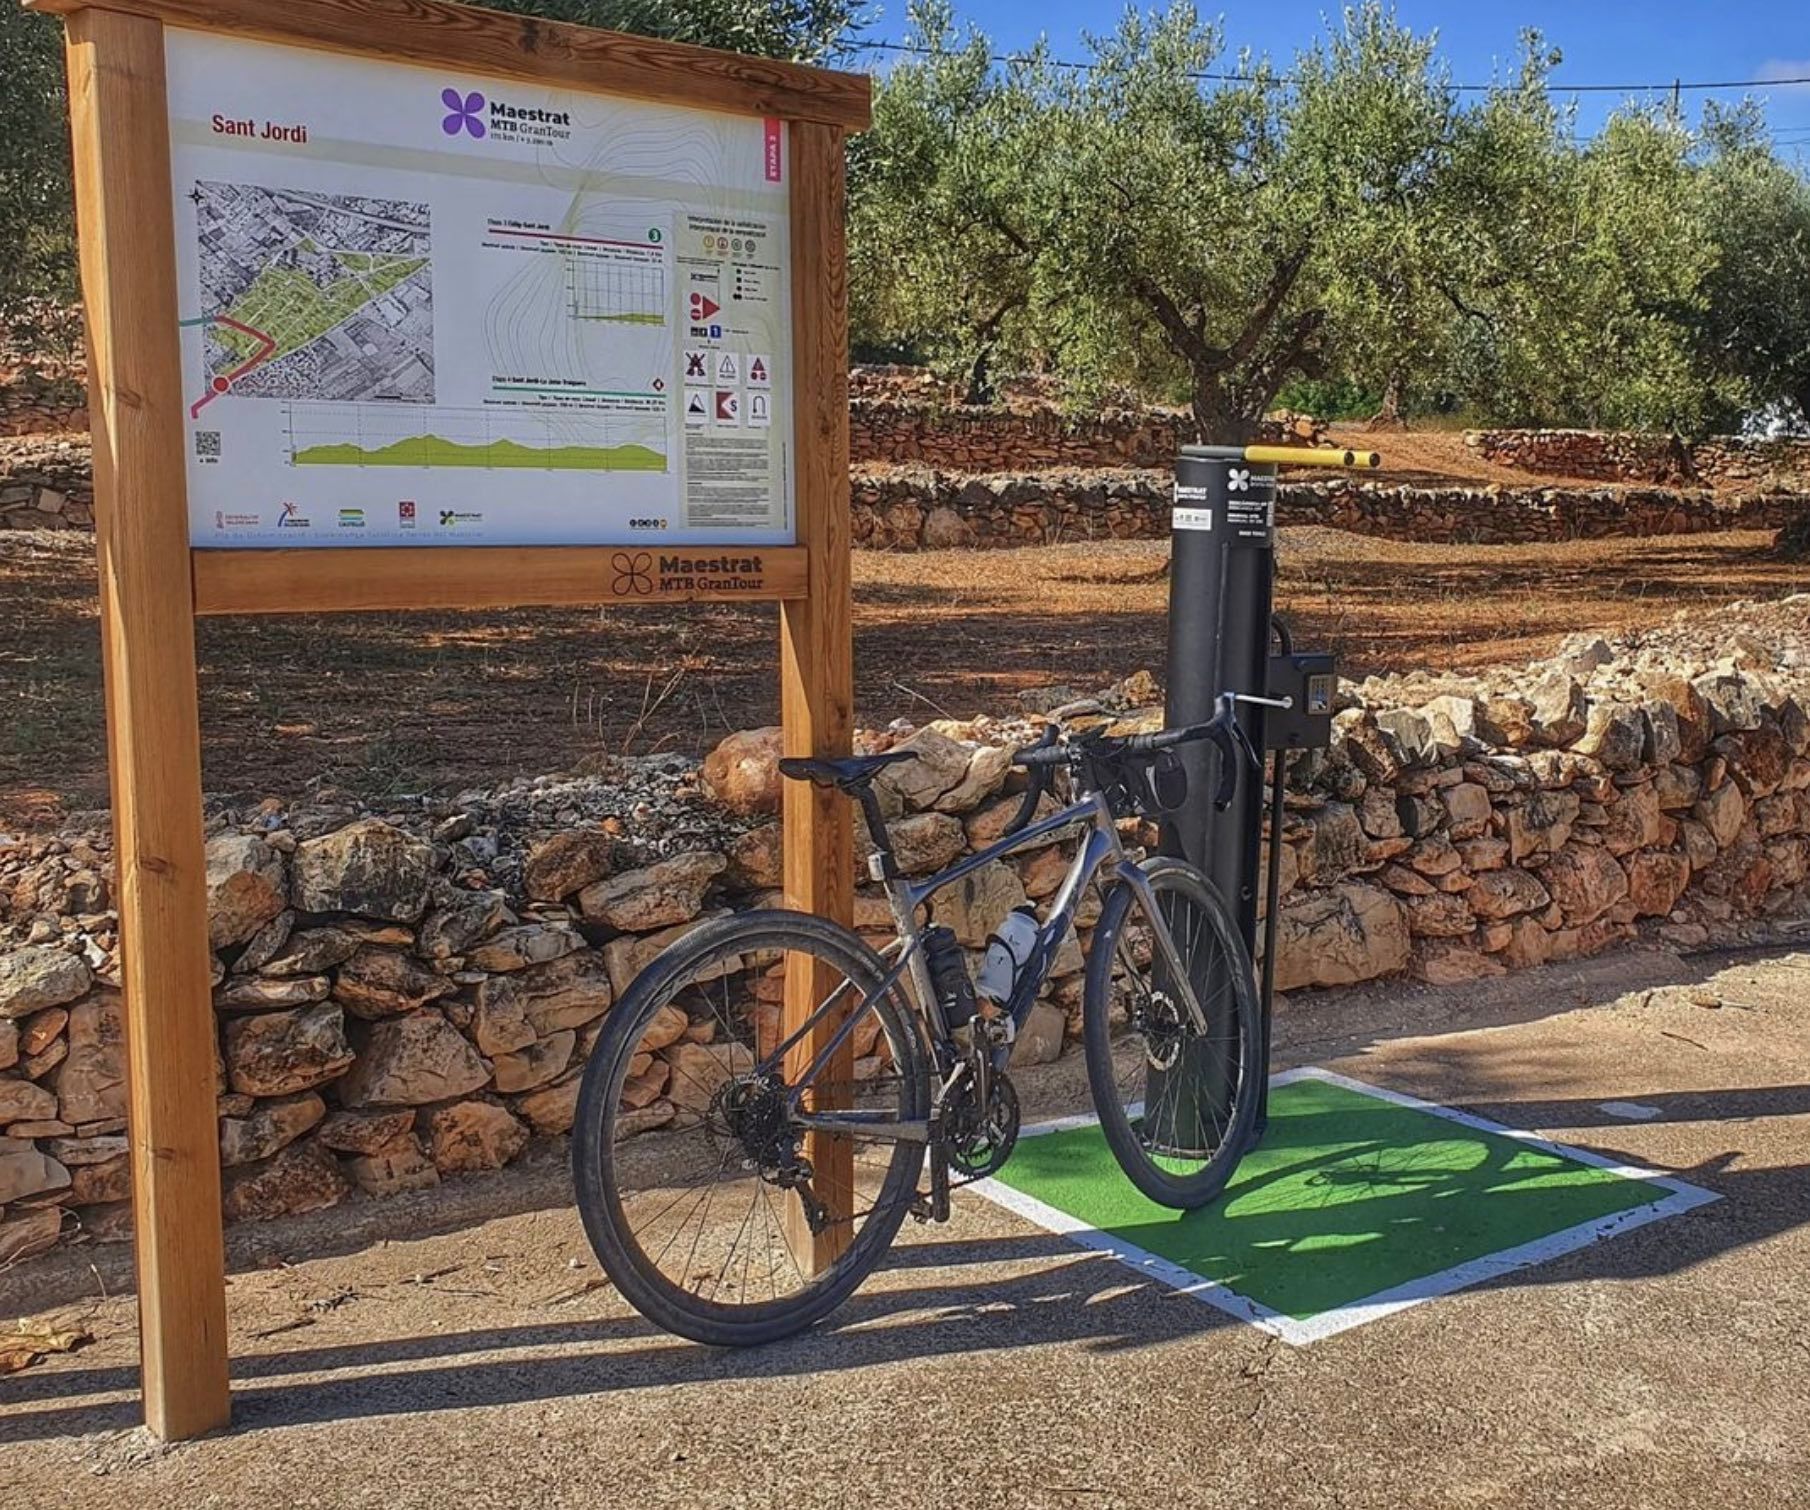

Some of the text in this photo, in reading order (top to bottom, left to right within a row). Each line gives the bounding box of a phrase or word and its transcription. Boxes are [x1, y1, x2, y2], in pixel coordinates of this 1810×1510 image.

[490, 101, 570, 126] Maestrat
[212, 114, 308, 143] Sant Jordi
[490, 119, 571, 139] MTB GranTour
[769, 143, 777, 177] ETAPA
[730, 399, 738, 412] S
[659, 555, 763, 574] Maestrat
[659, 576, 763, 591] MTB GranTour
